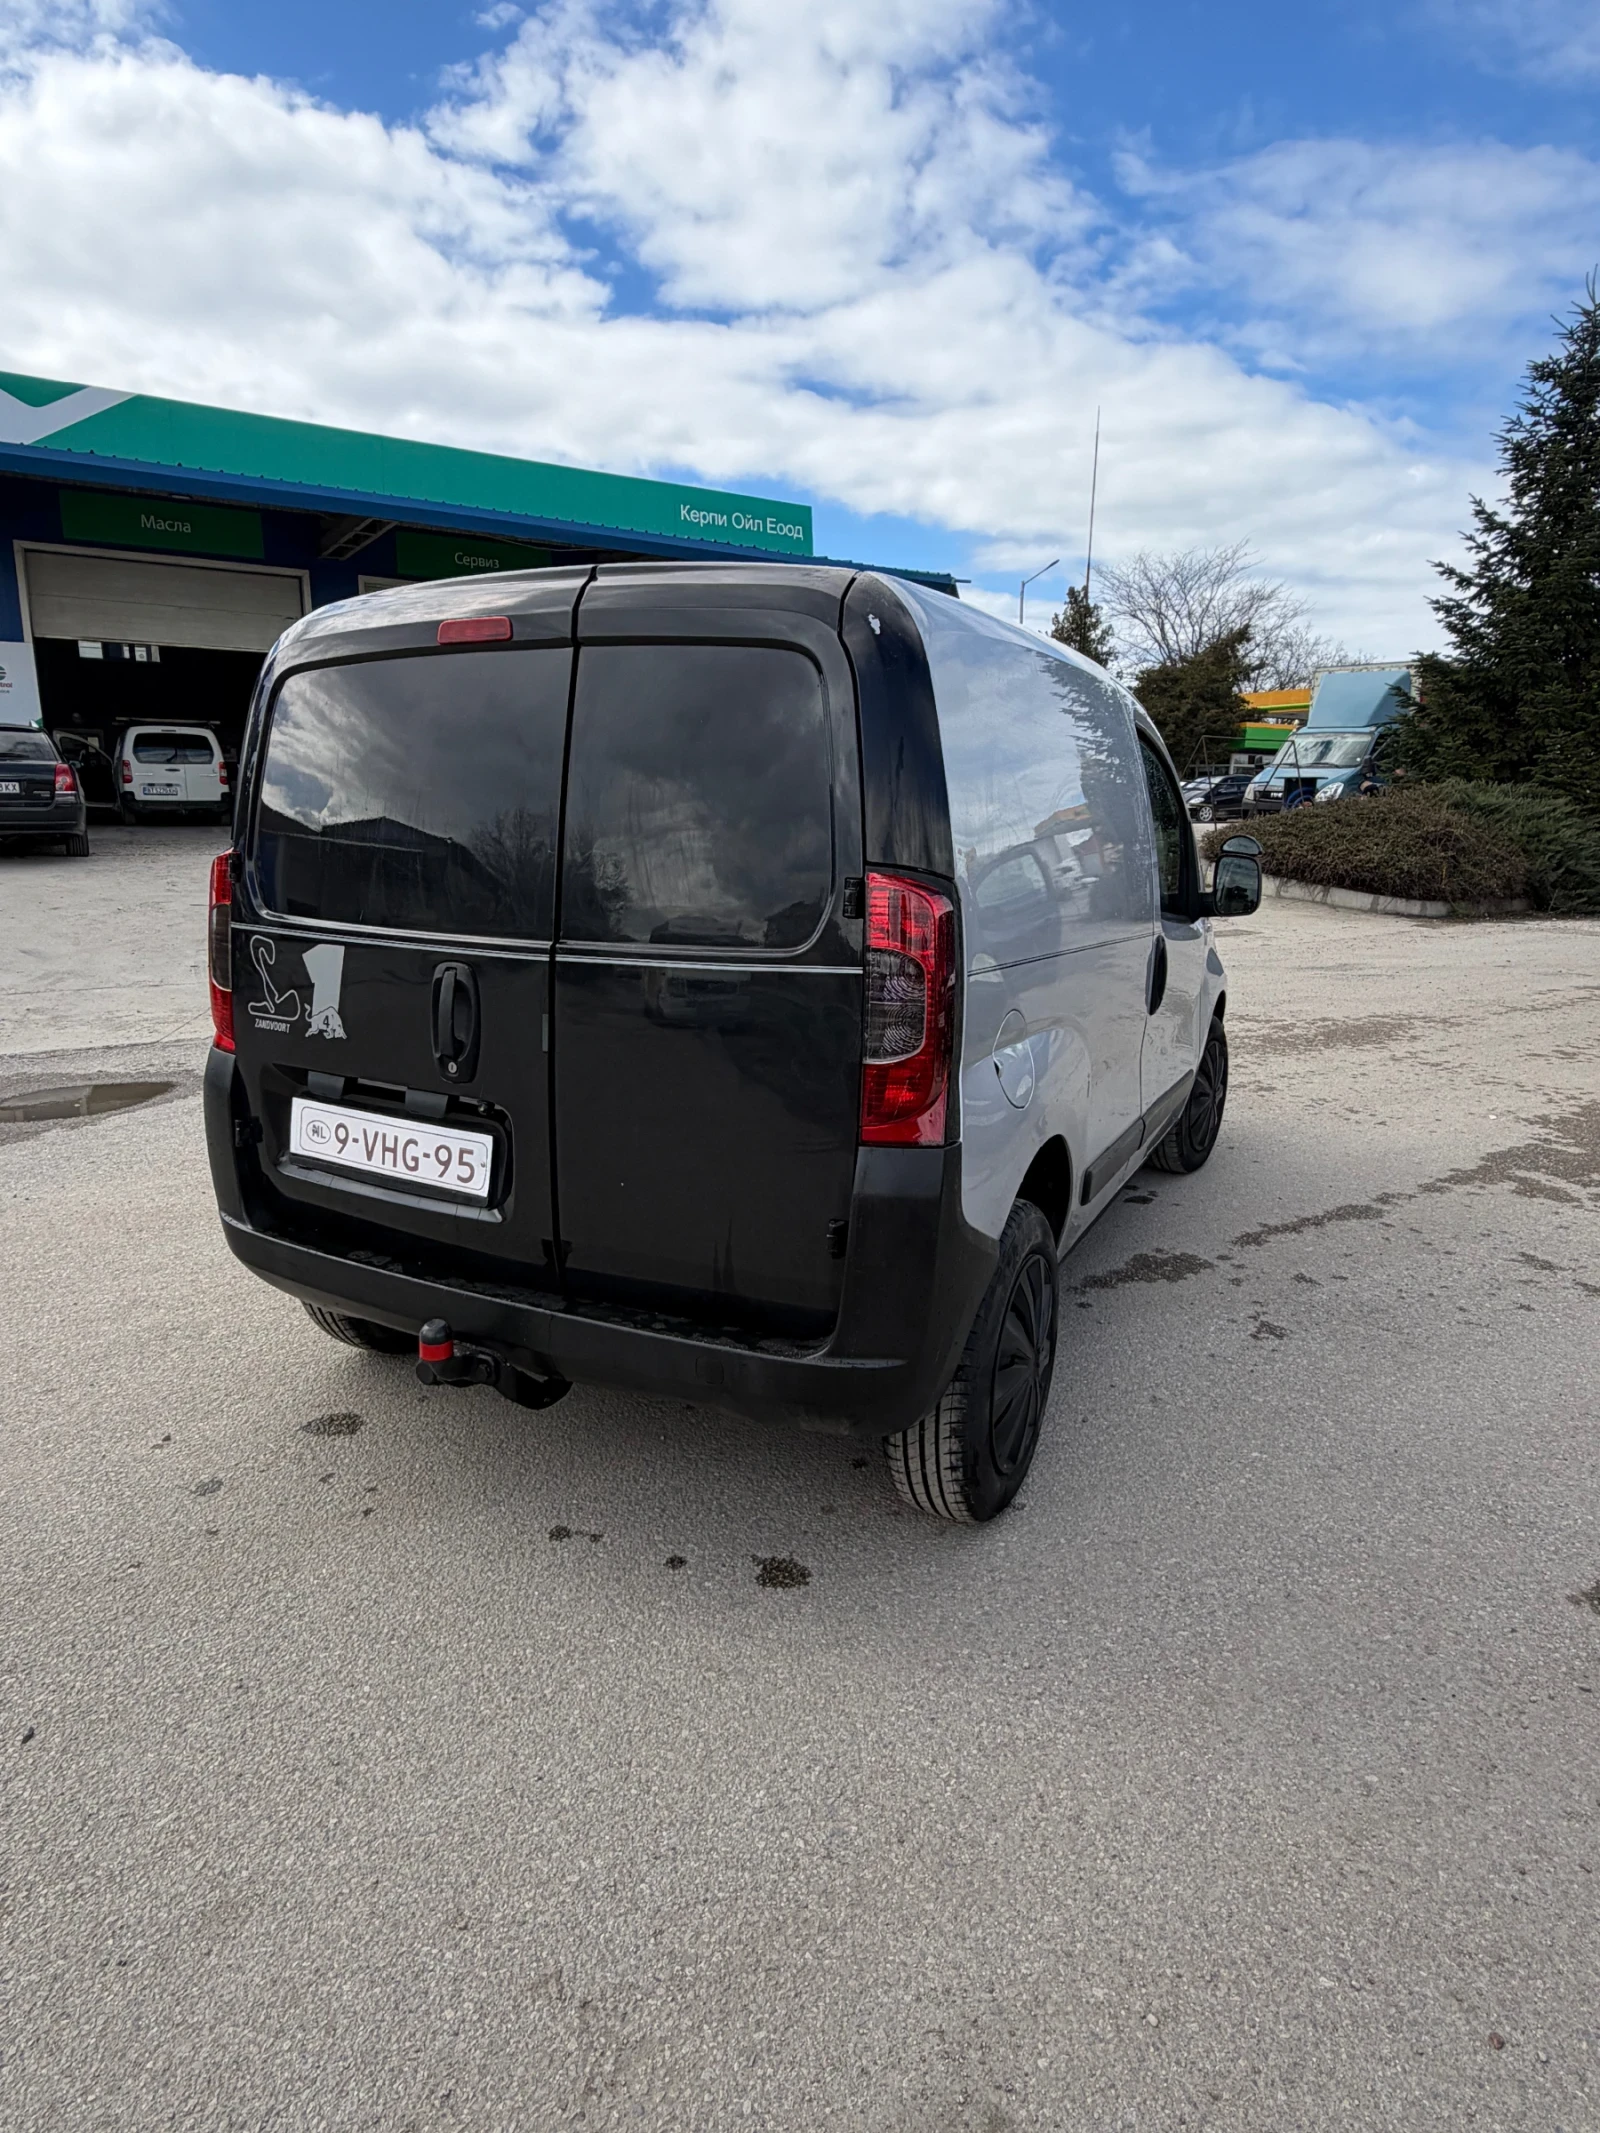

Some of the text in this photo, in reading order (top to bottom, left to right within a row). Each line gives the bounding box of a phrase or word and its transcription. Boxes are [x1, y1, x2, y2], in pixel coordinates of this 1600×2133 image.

[140, 513, 192, 533] Масла
[680, 504, 804, 541] Керпи Ойл Еоод
[454, 551, 500, 569] Сервиз
[254, 1018, 291, 1034] ZANDVOORT
[334, 1122, 476, 1184] 9-VHG-95
